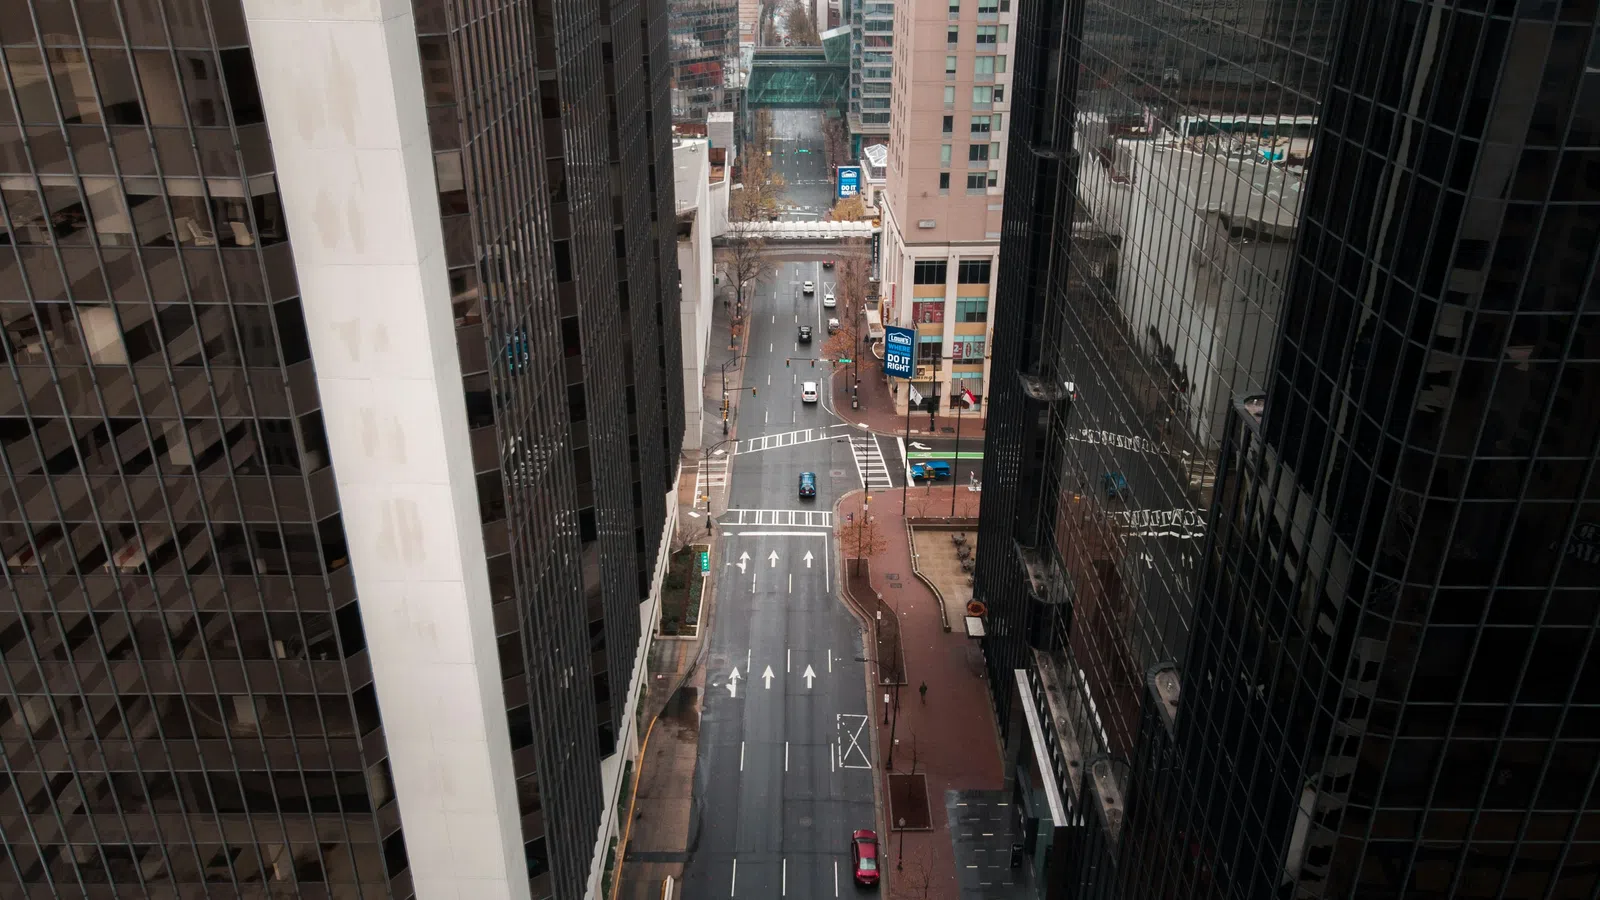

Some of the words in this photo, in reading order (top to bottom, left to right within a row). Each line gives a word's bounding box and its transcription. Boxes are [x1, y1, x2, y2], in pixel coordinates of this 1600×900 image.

[888, 343, 910, 352] WHERE
[887, 353, 900, 363] DO
[901, 356, 910, 365] IT
[887, 362, 910, 372] RIGHT
